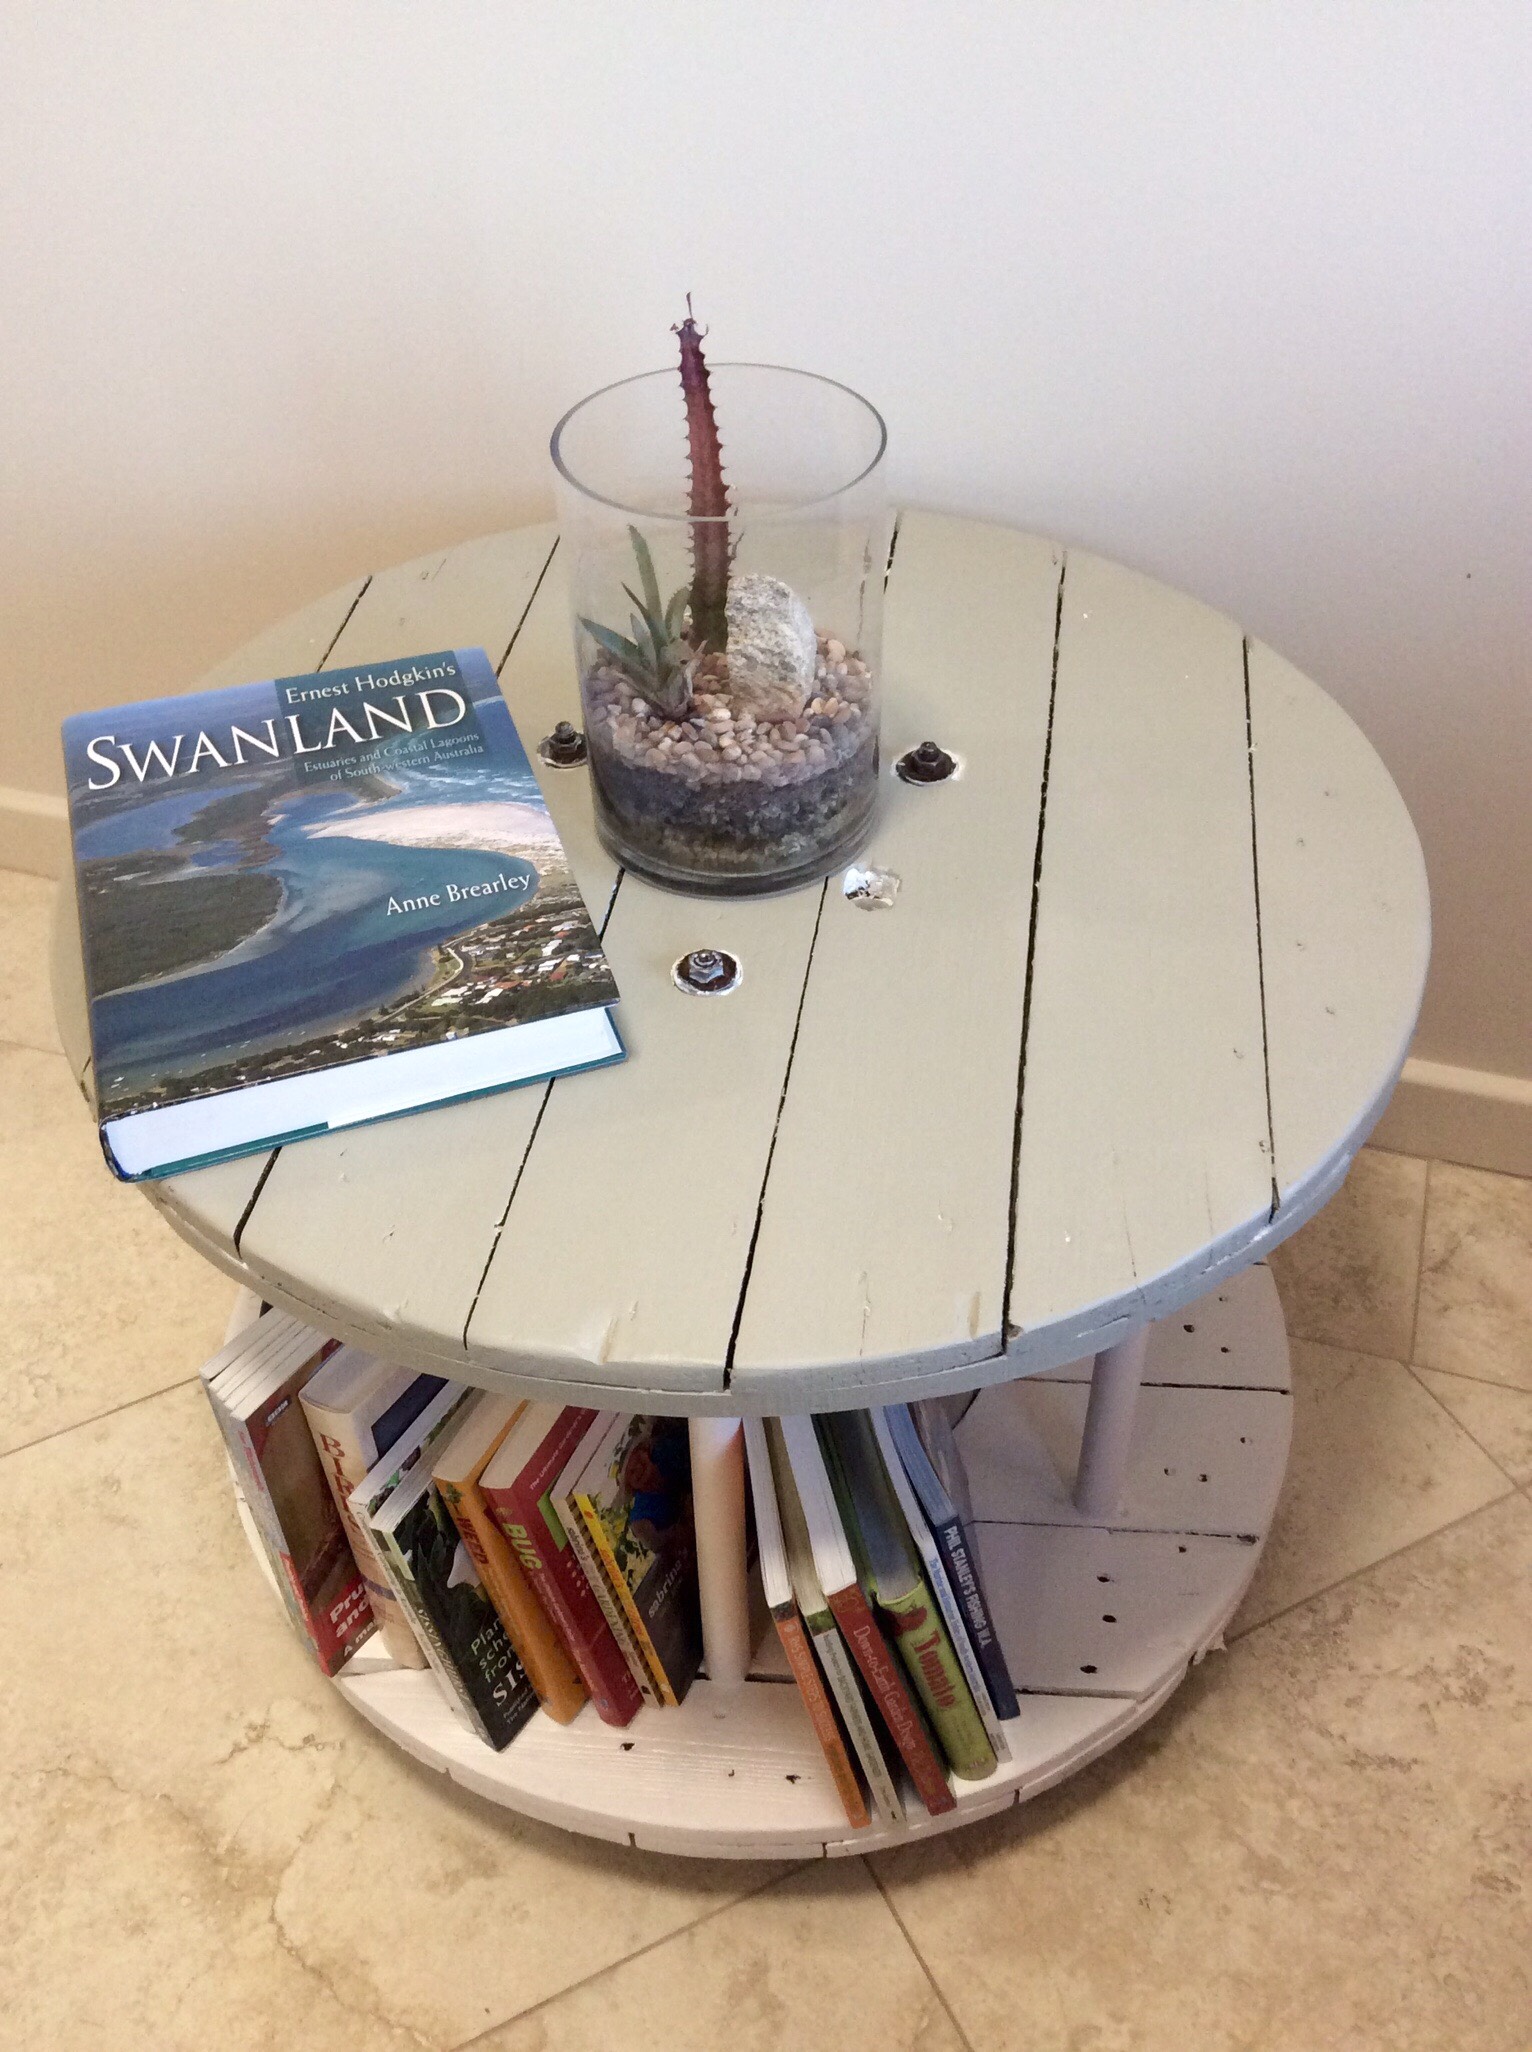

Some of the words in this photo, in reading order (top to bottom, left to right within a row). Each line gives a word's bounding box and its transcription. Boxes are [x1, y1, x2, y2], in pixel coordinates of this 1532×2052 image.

[286, 682, 349, 704] Ernest
[354, 662, 457, 692] Hodgkin's
[85, 688, 467, 791] SWANLAND
[304, 755, 357, 772] Estuaries
[359, 750, 381, 763] and
[383, 739, 429, 757] Coastal
[430, 732, 480, 750] Lagoons
[330, 769, 343, 782] of
[344, 754, 431, 780] South-western
[434, 744, 485, 762] Australia
[386, 893, 441, 916] Anne
[446, 872, 531, 903] Brearley
[501, 1522, 543, 1571] BUG
[944, 1525, 962, 1550] PHIL
[951, 1547, 976, 1602] STANLEY'S
[966, 1592, 987, 1635] FISHING
[910, 1628, 957, 1709] Tomato
